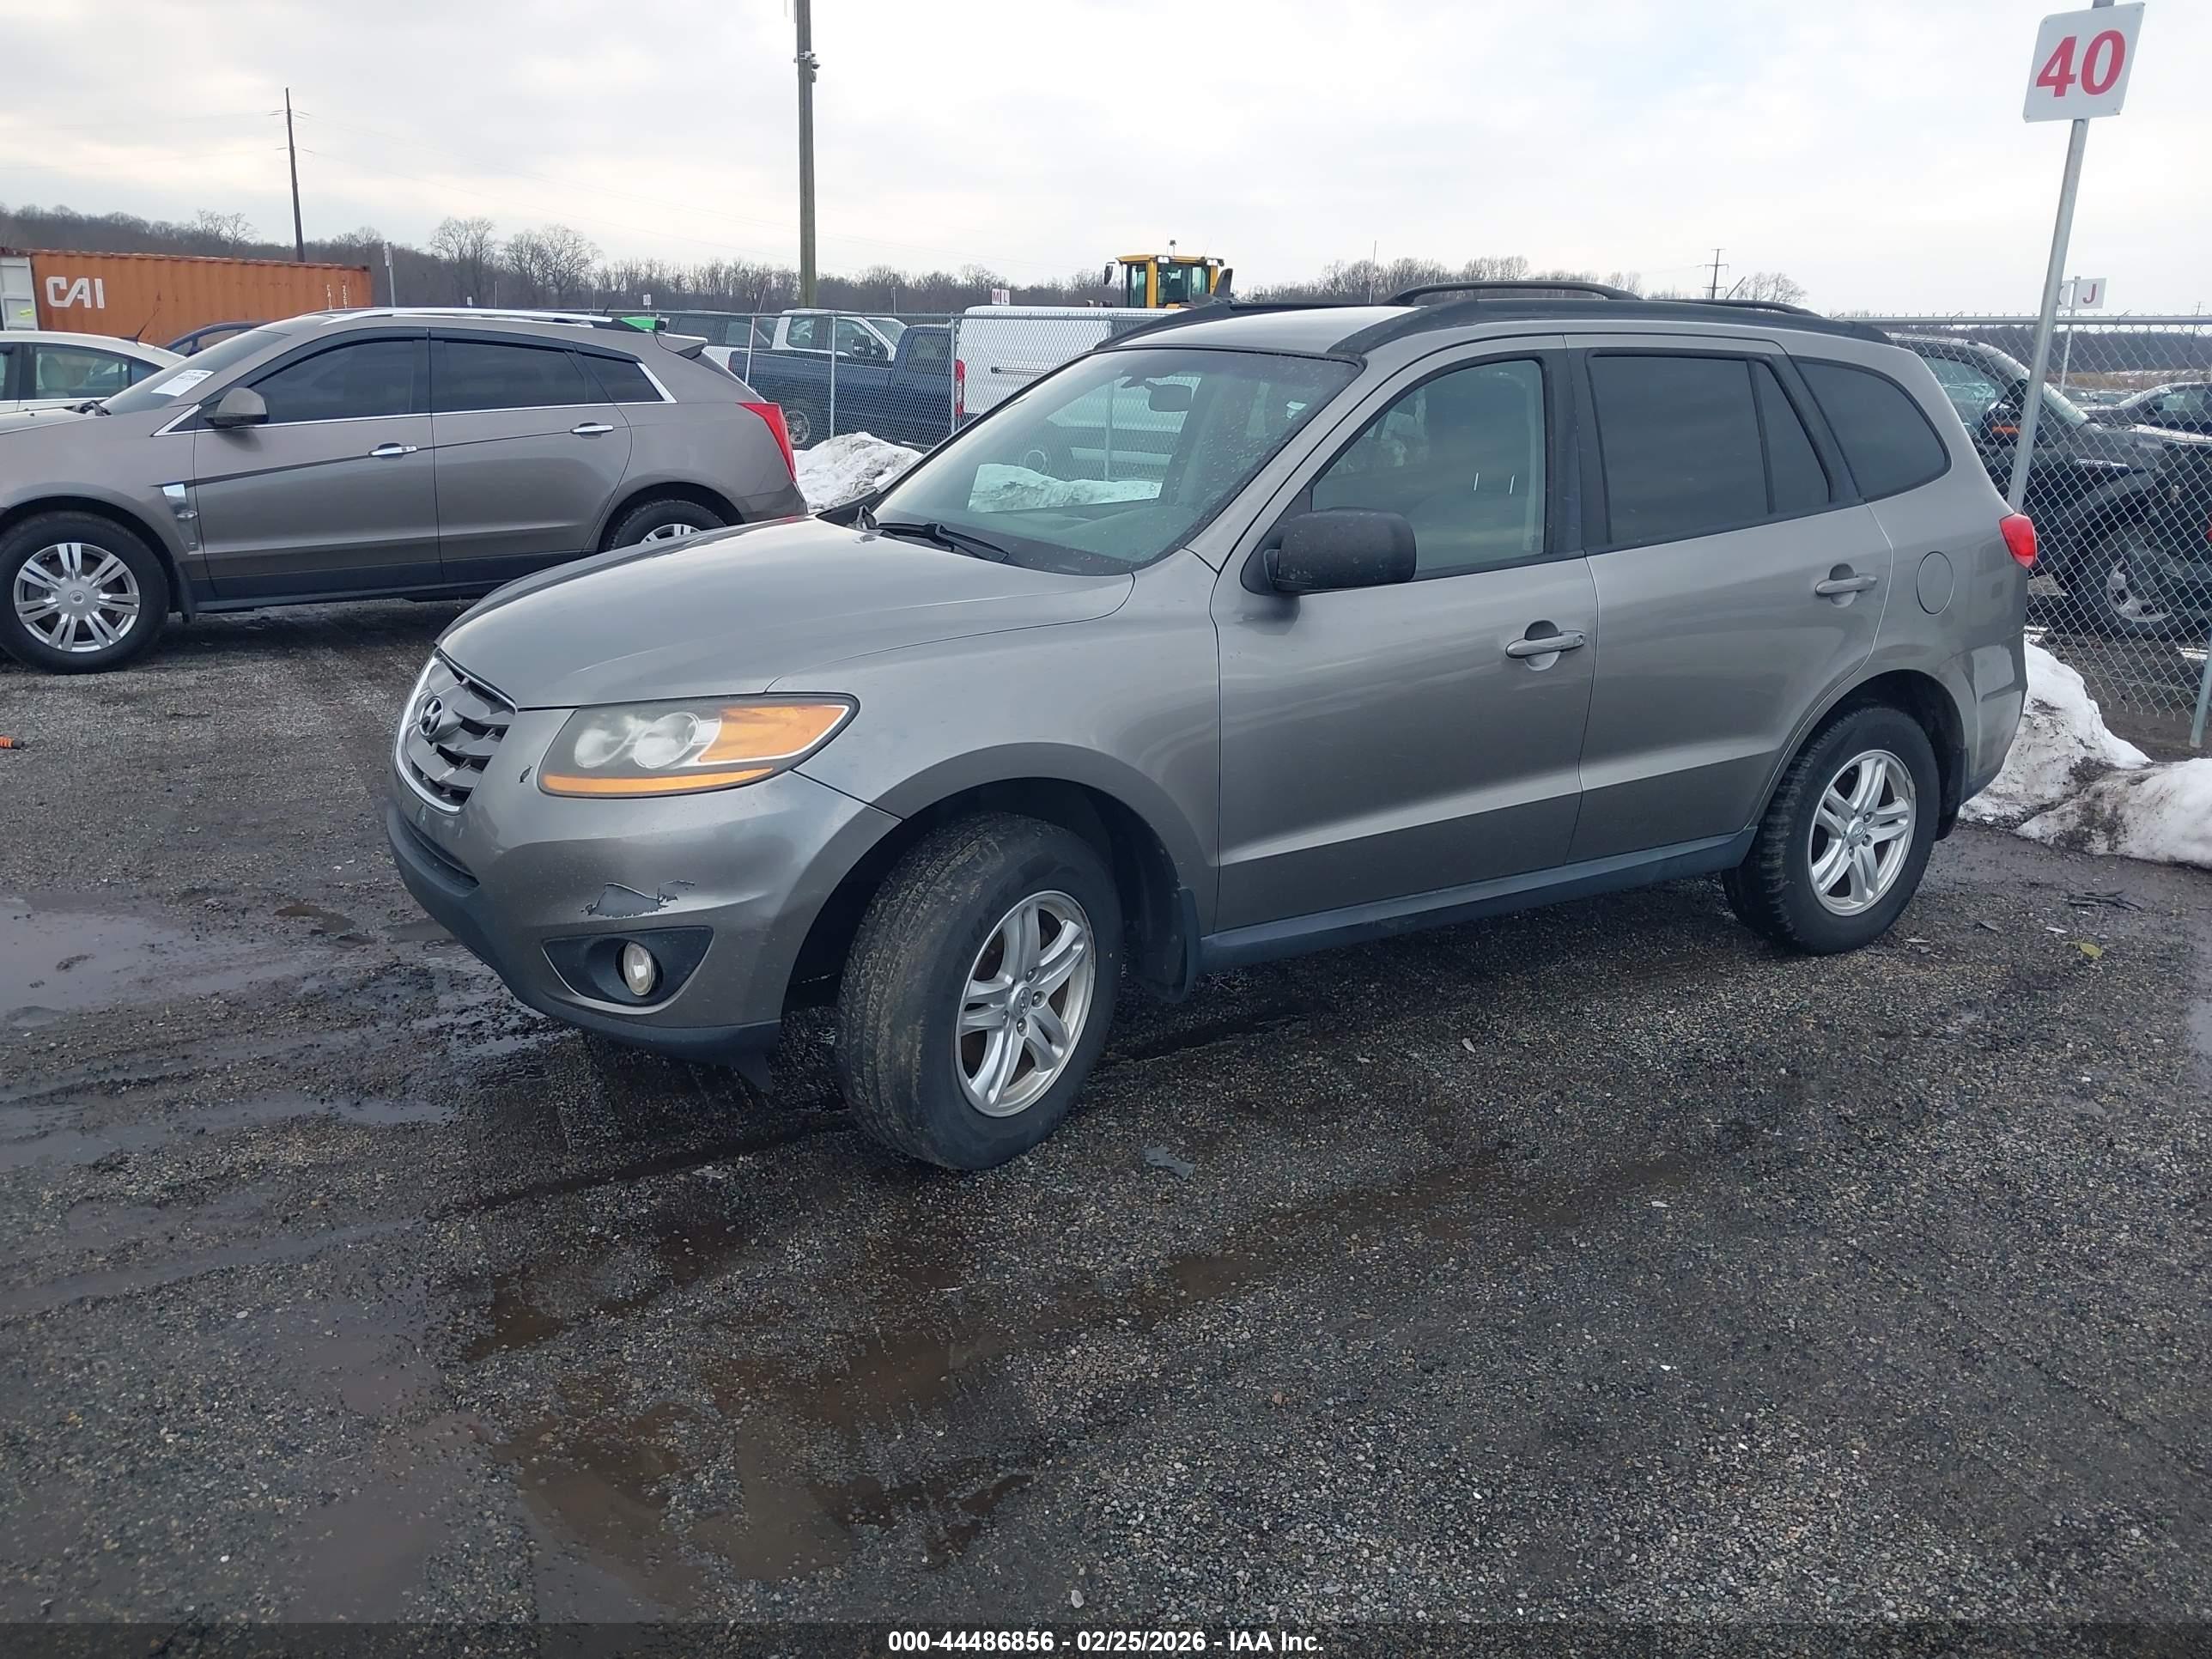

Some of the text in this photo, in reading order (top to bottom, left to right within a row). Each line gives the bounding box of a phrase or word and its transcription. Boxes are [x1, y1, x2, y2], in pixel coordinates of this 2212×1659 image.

[2036, 29, 2126, 98] 40
[46, 276, 105, 309] CAI
[993, 290, 1000, 303] M
[2082, 283, 2097, 304] J
